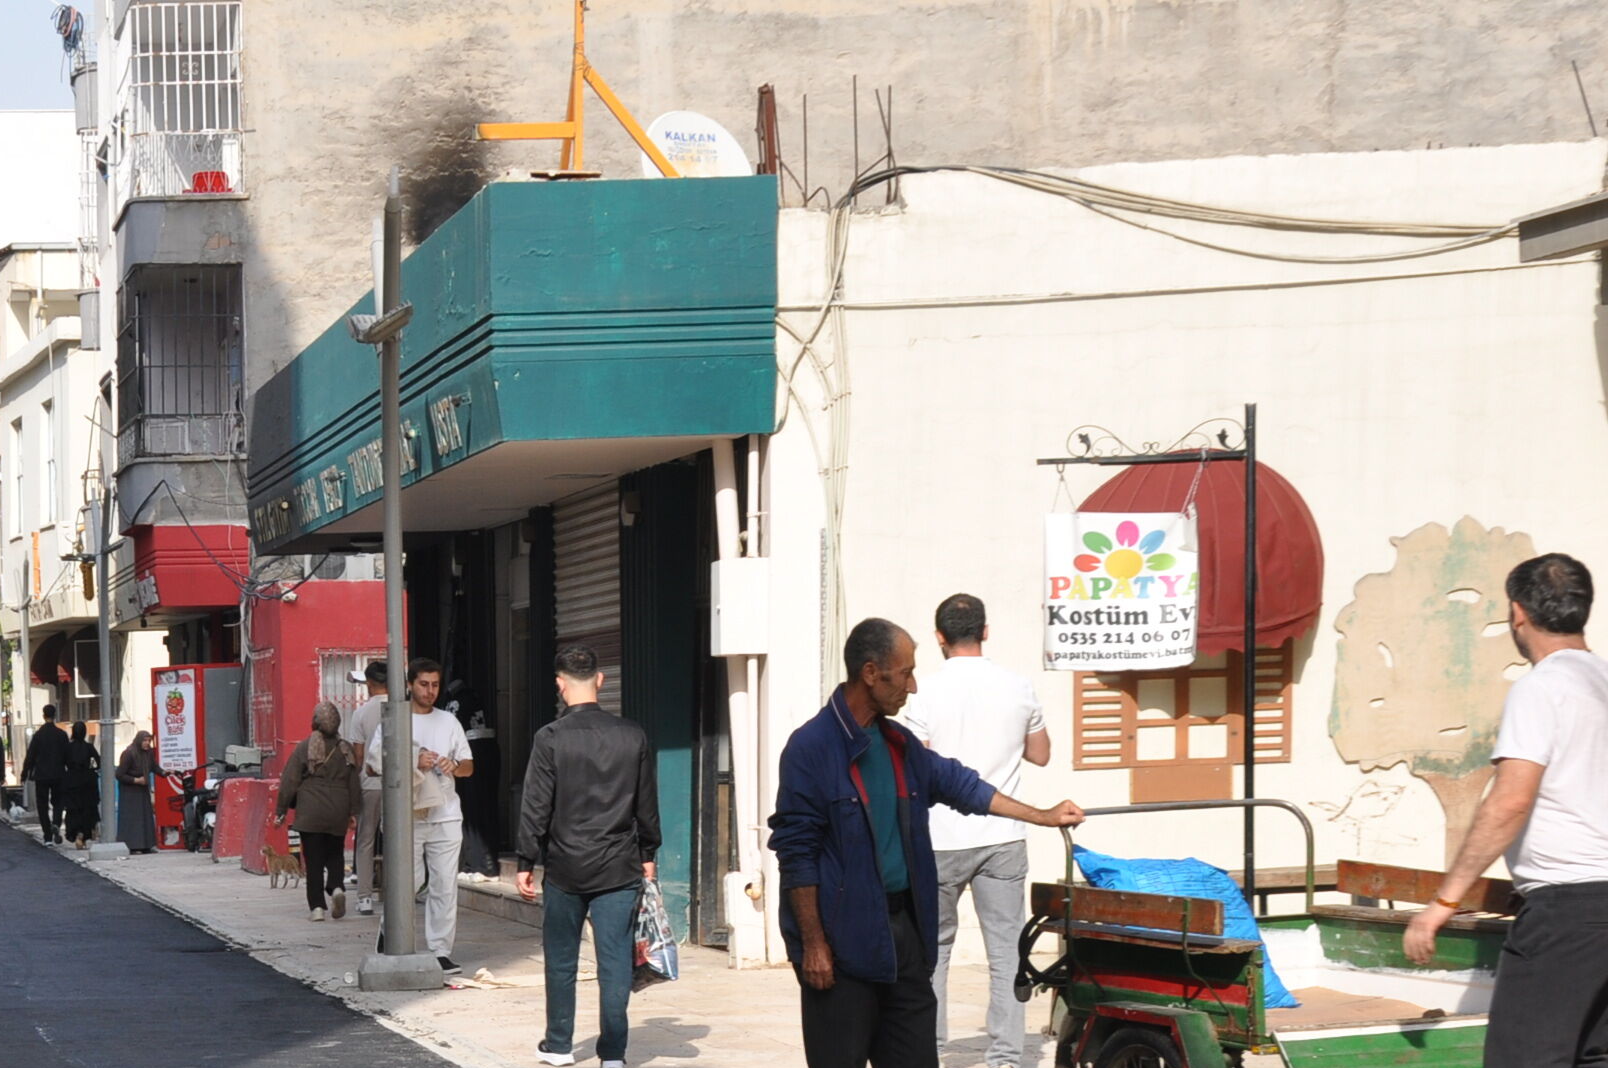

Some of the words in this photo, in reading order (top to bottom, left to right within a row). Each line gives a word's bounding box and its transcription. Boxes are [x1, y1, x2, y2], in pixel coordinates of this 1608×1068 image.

[664, 130, 716, 142] KALKAN
[1047, 604, 1149, 626] Kostüm
[1159, 603, 1197, 624] Ev
[1057, 631, 1097, 645] 0535
[1102, 631, 1135, 645] 214
[1141, 630, 1165, 643] 06
[1170, 628, 1191, 641] 07
